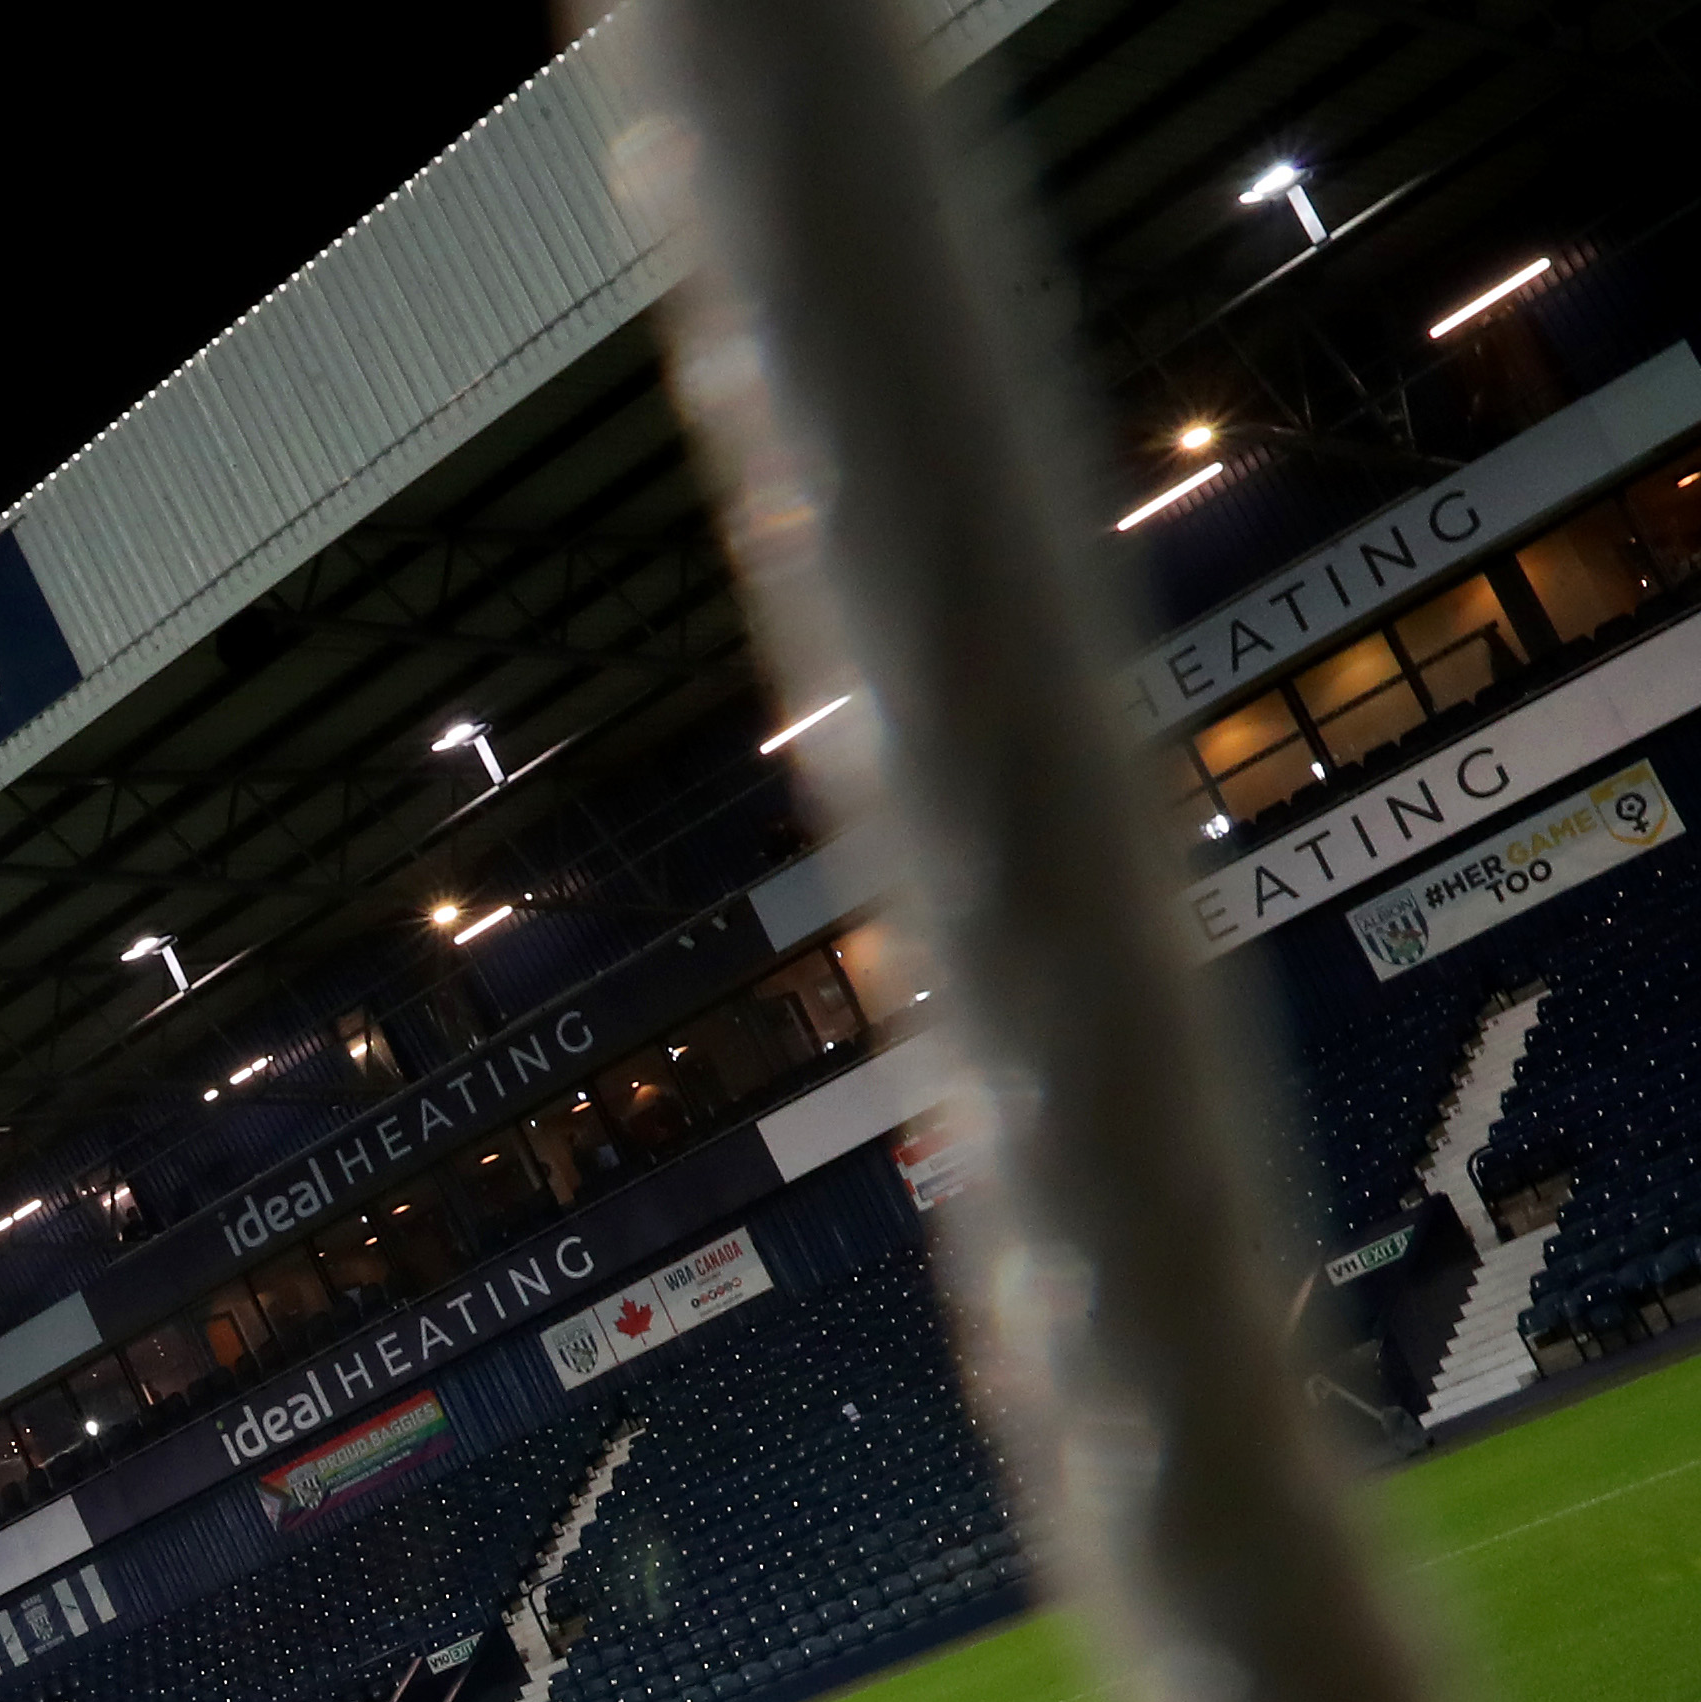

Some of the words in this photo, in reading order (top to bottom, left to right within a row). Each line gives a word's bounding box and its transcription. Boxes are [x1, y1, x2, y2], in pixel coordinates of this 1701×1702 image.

[1485, 858, 1553, 903] TOO
[218, 1159, 334, 1258] ideal
[335, 1009, 596, 1182] HEATING
[664, 1265, 695, 1292] WBA
[694, 1239, 744, 1277] CANADA
[1332, 1259, 1358, 1278] V11
[217, 1371, 334, 1467] ideal
[335, 1234, 596, 1401] HEATING
[316, 1437, 368, 1475] PROUD
[368, 1402, 438, 1447] BAGGIES
